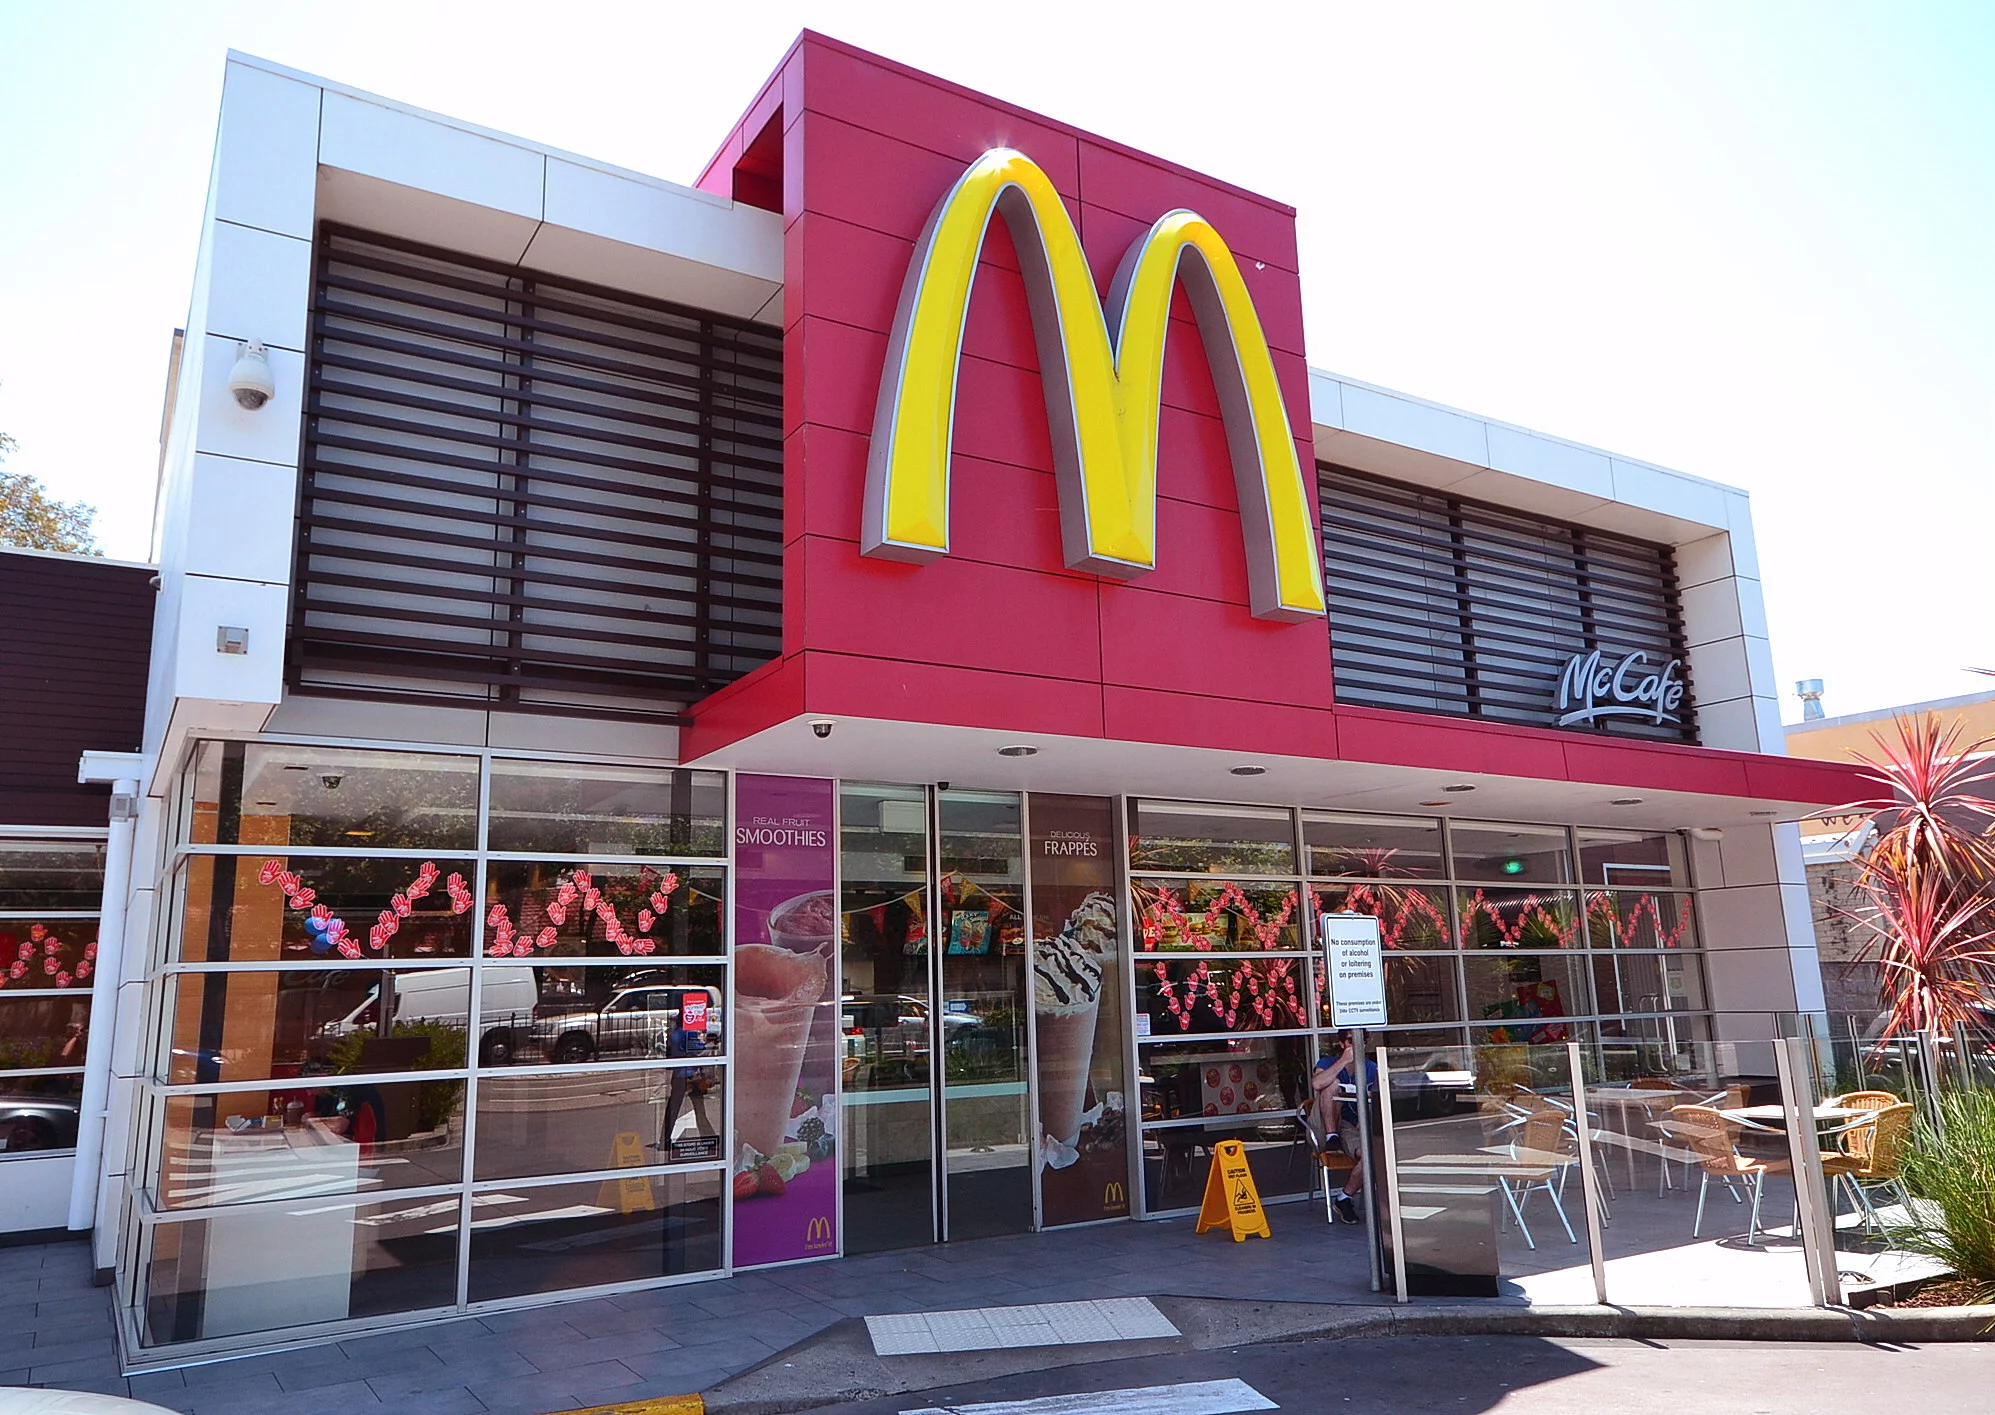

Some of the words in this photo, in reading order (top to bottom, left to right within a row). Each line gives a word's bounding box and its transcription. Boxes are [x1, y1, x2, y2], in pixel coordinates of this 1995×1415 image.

[862, 148, 1327, 622] M
[1559, 649, 1684, 725] McCafé
[753, 816, 780, 826] REAL
[782, 818, 810, 827] FRUIT
[736, 827, 826, 847] SMOOTHIES
[1050, 830, 1091, 839] DELICIOUS
[1044, 838, 1098, 857] FRAPPÉS
[1341, 939, 1376, 947] consumption
[1349, 949, 1369, 957] alcohol
[1349, 960, 1371, 968] loitering
[1348, 971, 1374, 980] premises
